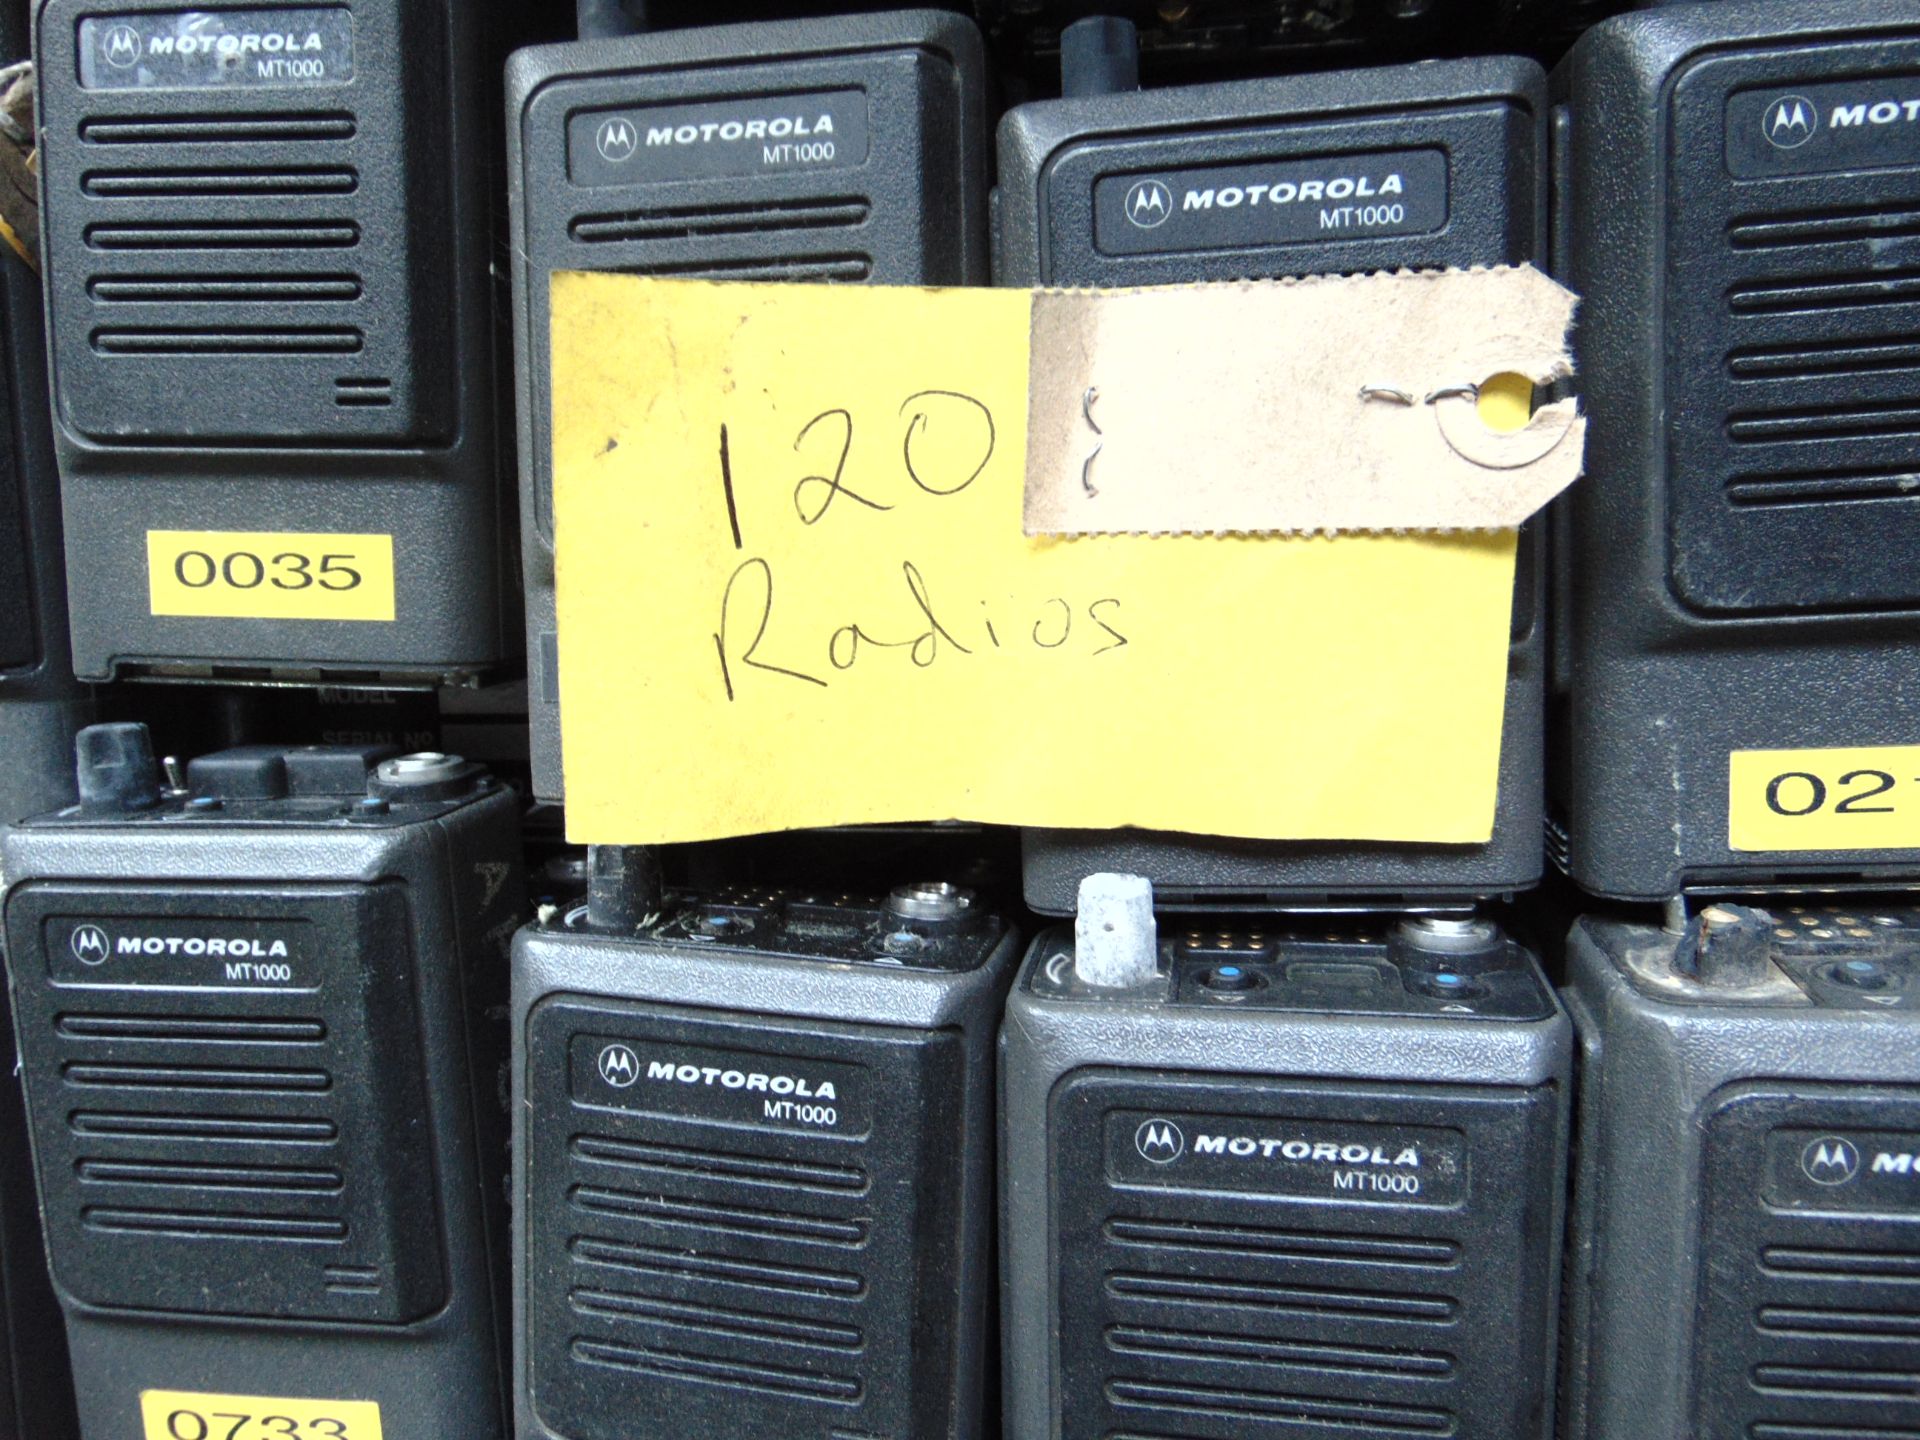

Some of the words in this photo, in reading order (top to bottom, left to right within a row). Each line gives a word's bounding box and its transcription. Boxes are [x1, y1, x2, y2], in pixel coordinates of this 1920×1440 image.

[150, 33, 323, 55] MOTOROLA
[257, 59, 324, 79] MT1000
[646, 114, 834, 147] MOTOROLA
[762, 140, 836, 166] MT1000
[1183, 173, 1403, 211] MOTOROLA
[1318, 203, 1405, 230] MT1000
[720, 390, 995, 549] 120
[176, 553, 362, 590] 0035
[712, 557, 1128, 702] Radios
[1765, 769, 1920, 816] 02
[117, 936, 288, 958] MOTOROLA
[225, 963, 292, 982] MT1000
[647, 1061, 836, 1101] MOTOROLA
[762, 1099, 838, 1128] MT1000
[1194, 1135, 1419, 1167] MOTOROLA
[1332, 1170, 1420, 1195] MT1000
[167, 1410, 347, 1440] 0733
